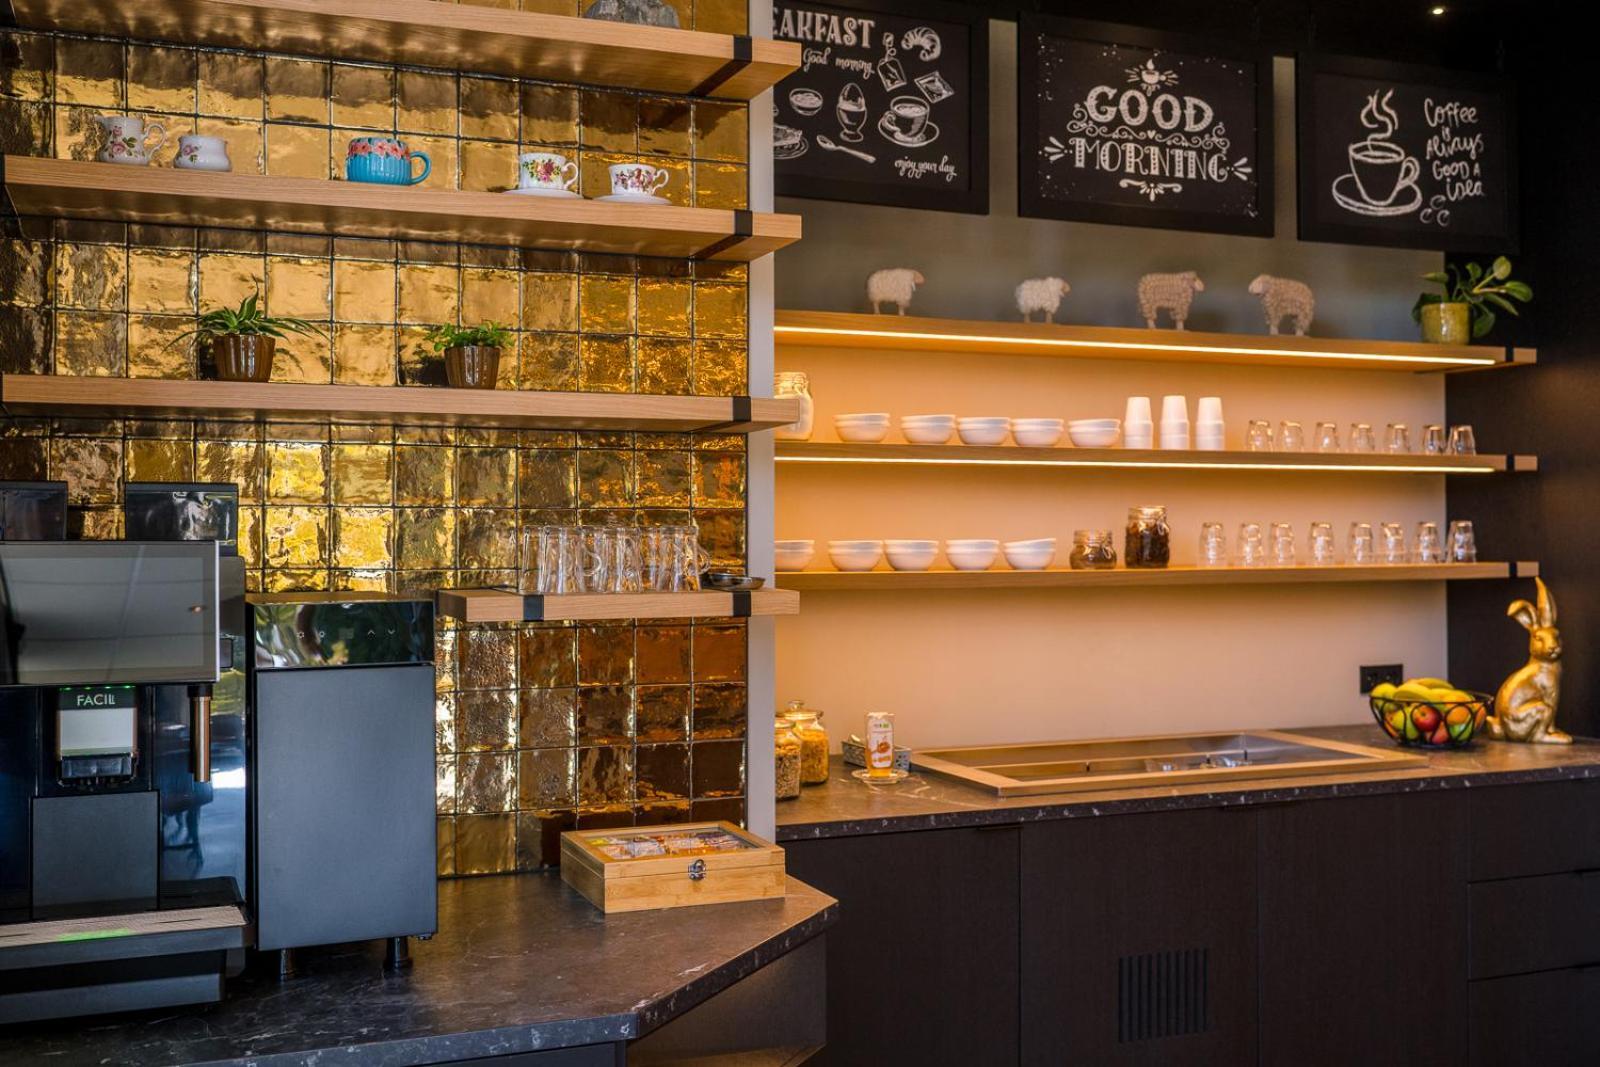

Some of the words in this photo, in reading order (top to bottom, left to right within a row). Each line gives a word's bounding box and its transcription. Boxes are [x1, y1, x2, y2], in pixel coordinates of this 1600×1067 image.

[1084, 85, 1214, 132] GOOD
[1424, 98, 1478, 127] Coffee
[938, 155, 957, 181] day
[1068, 137, 1228, 182] MORNING
